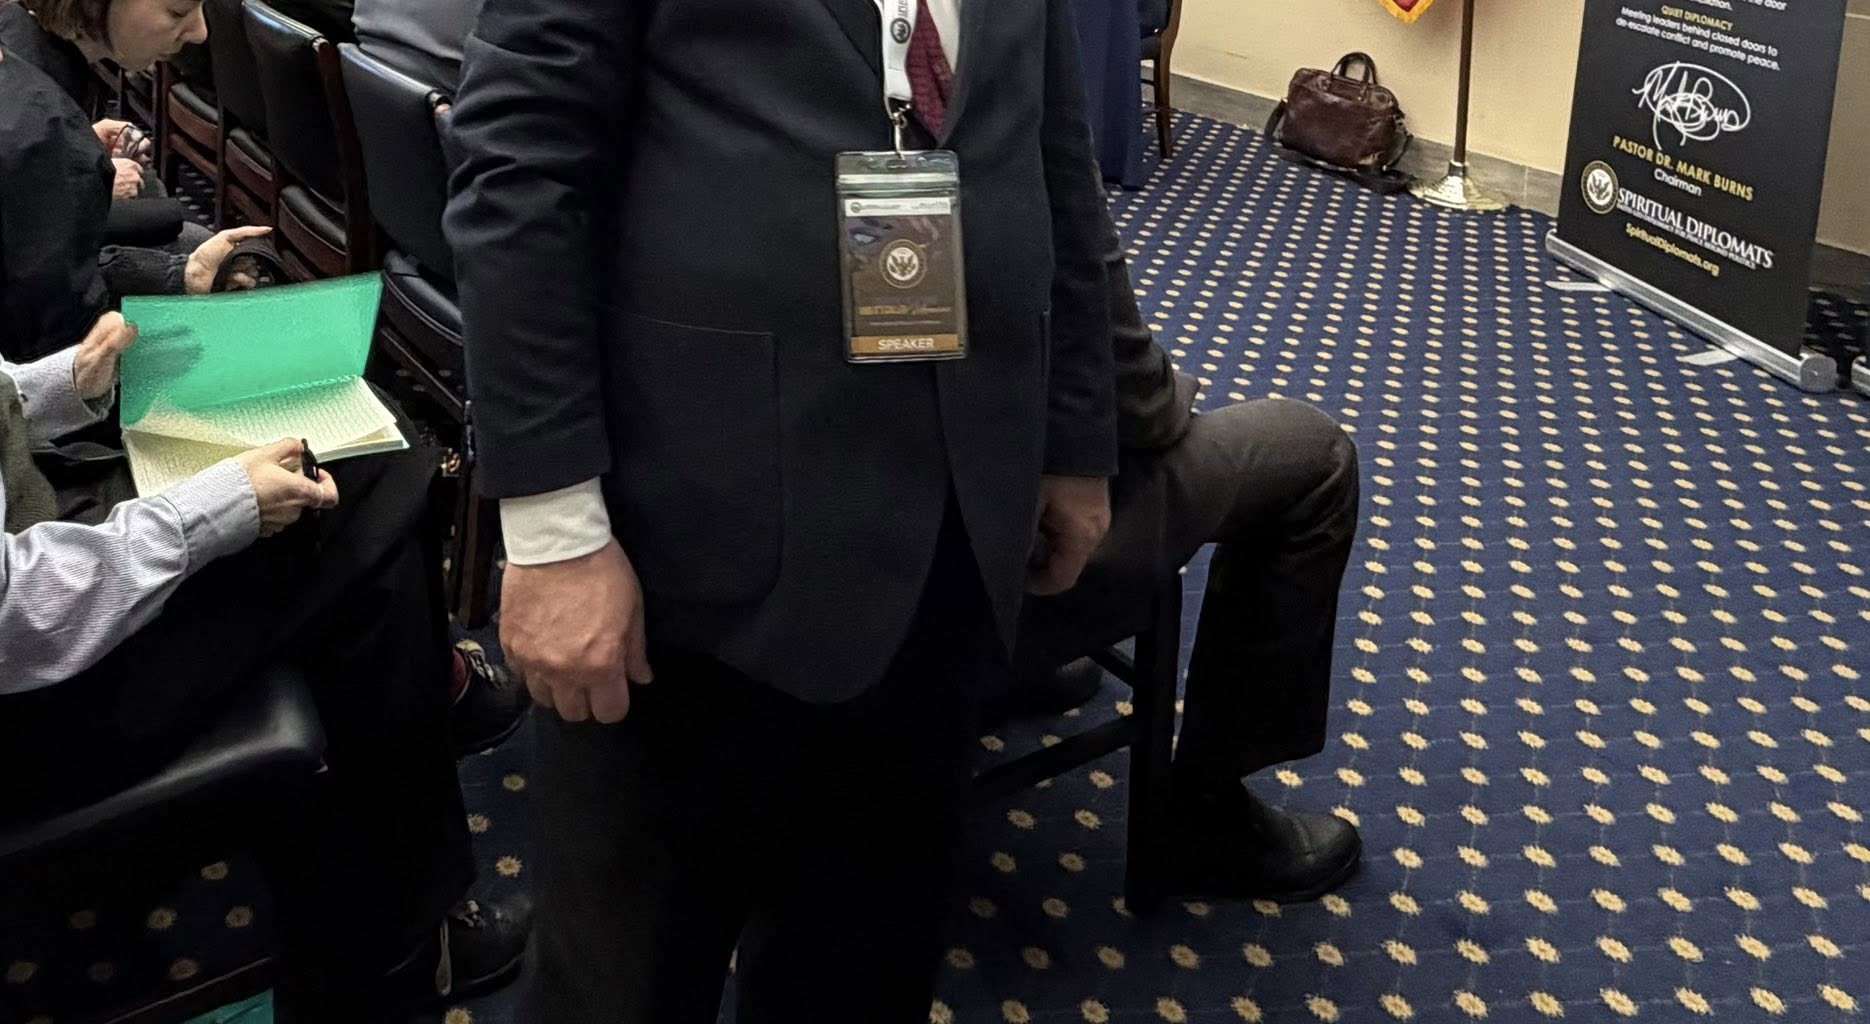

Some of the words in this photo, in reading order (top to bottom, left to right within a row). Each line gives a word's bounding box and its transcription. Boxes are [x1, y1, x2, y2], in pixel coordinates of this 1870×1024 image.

[1684, 11, 1733, 31] DIPLOMACY
[1682, 21, 1710, 38] behind
[1712, 31, 1740, 47] closed
[1741, 38, 1766, 53] doors
[1768, 46, 1778, 56] to
[1692, 36, 1708, 50] and
[1710, 41, 1746, 62] promote
[1613, 136, 1653, 161] PASTOR
[1656, 151, 1673, 169] DR.
[1676, 161, 1711, 184] MARK
[1714, 175, 1753, 200] BURNS
[1654, 169, 1702, 196] Chairman
[1617, 187, 1684, 229] SPIRITUAL
[1686, 215, 1774, 268] DIPLOMATS
[1627, 223, 1719, 276] SpiritualDiplomats.org
[878, 338, 934, 350] SPEAKER
